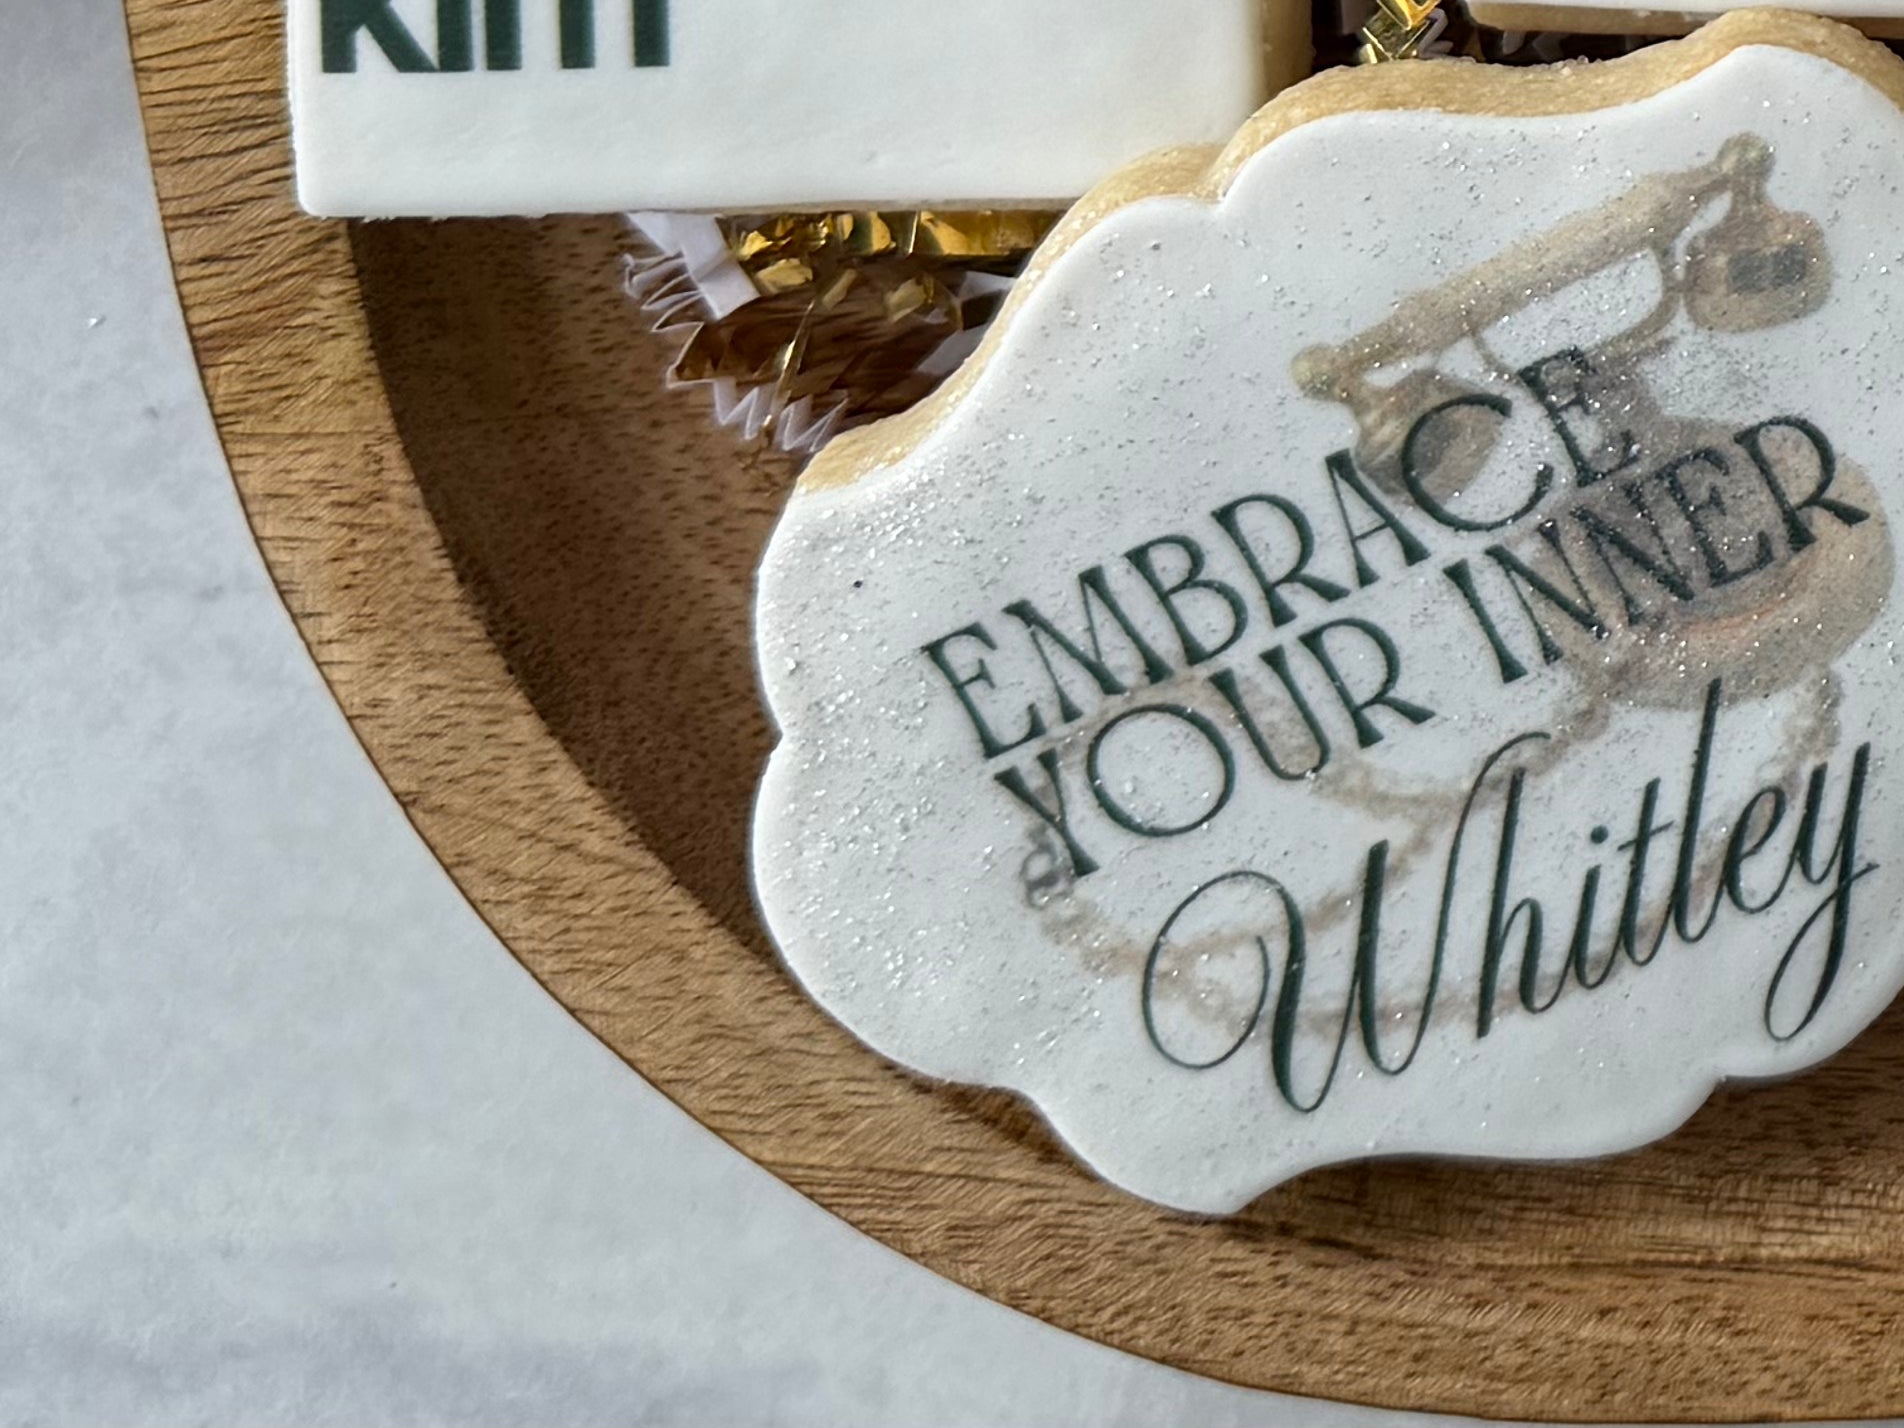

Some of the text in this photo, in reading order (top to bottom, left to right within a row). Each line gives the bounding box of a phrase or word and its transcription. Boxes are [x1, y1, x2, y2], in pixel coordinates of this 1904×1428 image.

[922, 346, 1640, 760] EMBRACE
[994, 413, 1871, 880] YOUR INNER
[1141, 677, 1879, 1114] Whitley
